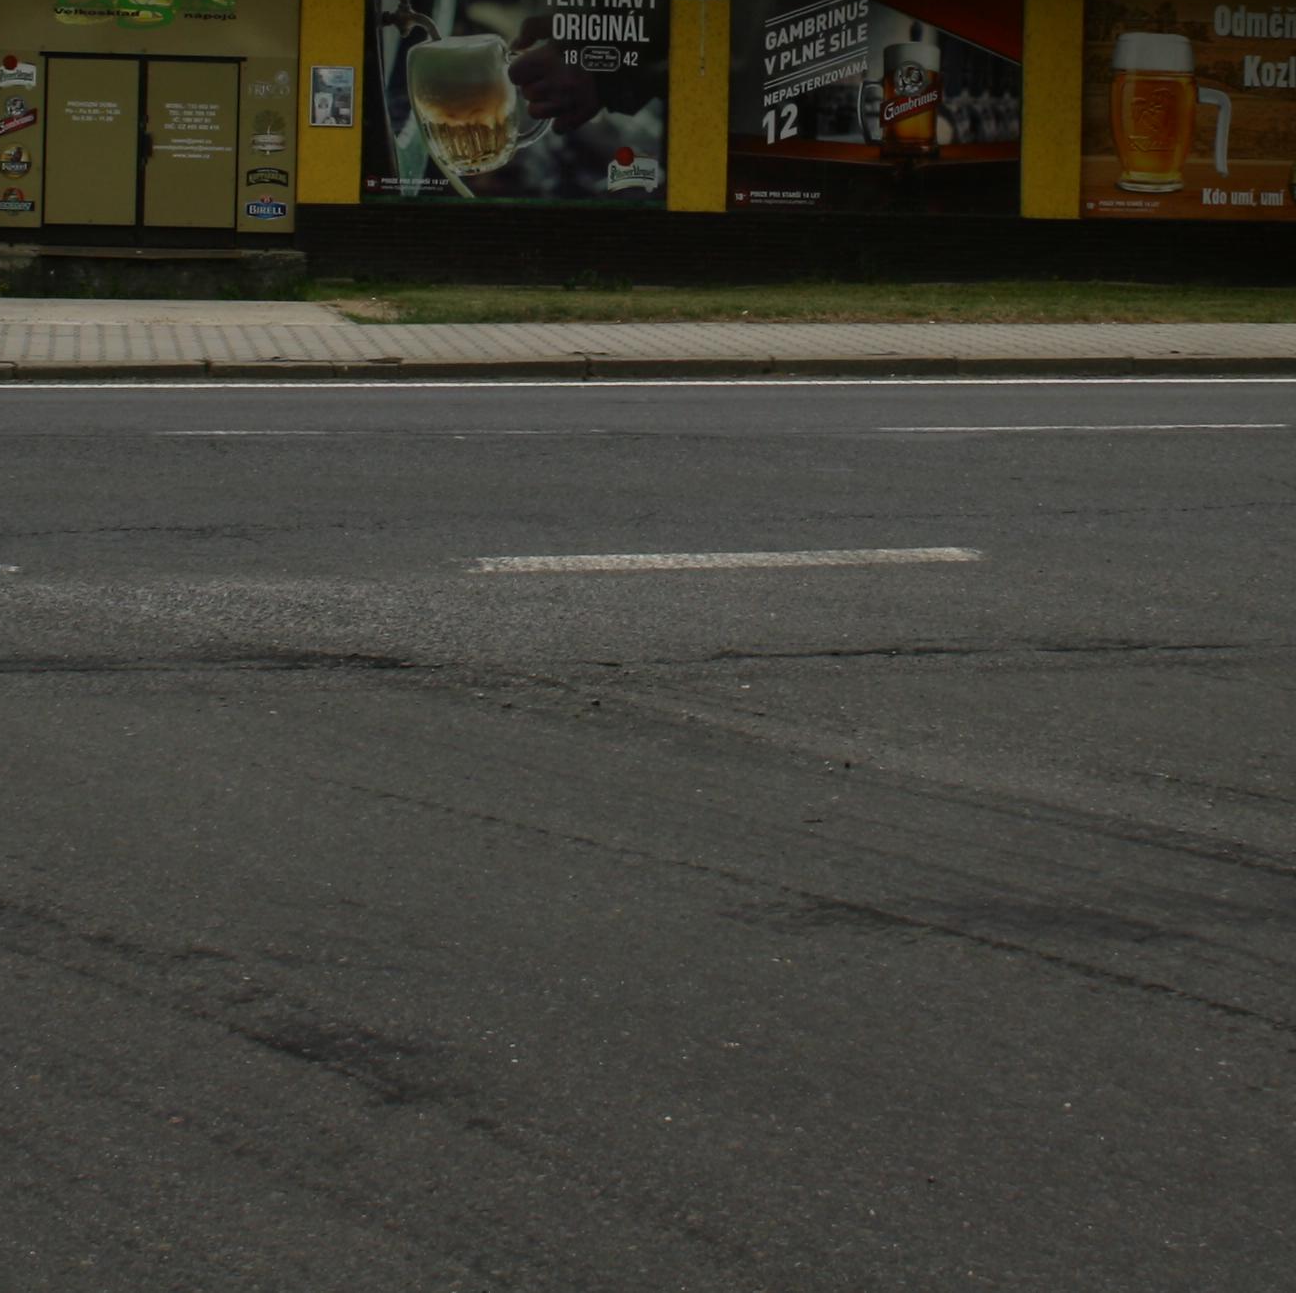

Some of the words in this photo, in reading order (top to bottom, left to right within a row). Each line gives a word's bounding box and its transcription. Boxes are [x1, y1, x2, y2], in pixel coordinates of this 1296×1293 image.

[54, 7, 140, 18] Velkosklad
[552, 11, 650, 42] ORIGINÁL
[564, 49, 578, 65] 18
[623, 52, 638, 66] 42
[764, 57, 777, 76] V
[779, 35, 825, 72] PLNÉ
[829, 23, 868, 52] SÍLE
[764, 57, 868, 107] NEPASTERIZOVANÁ
[884, 90, 938, 121] Gambrinus
[762, 103, 799, 146] 12
[248, 205, 284, 215] BIRELL
[1202, 187, 1226, 205] Kdo
